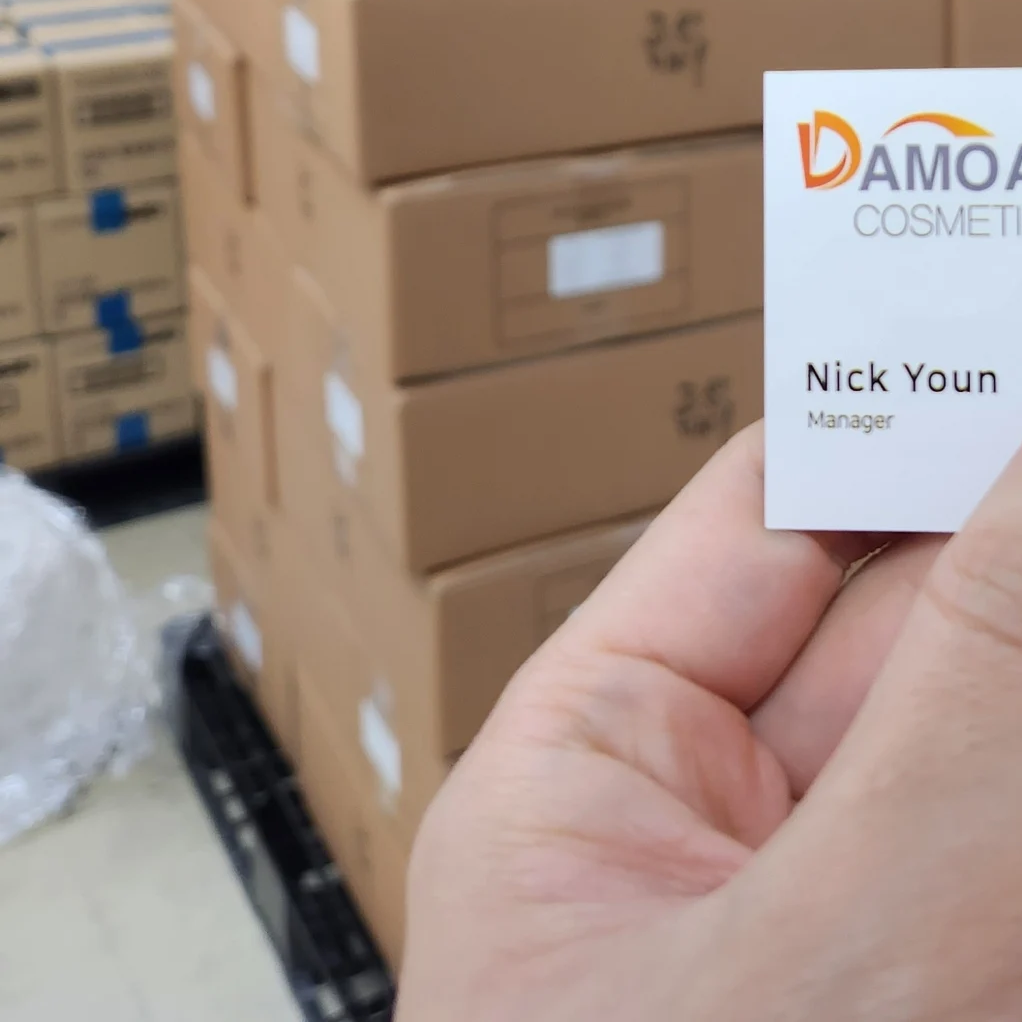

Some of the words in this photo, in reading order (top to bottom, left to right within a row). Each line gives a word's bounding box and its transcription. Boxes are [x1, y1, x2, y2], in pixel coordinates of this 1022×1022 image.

[807, 360, 889, 393] Nick
[903, 362, 999, 394] Youn
[808, 410, 895, 435] Manager
